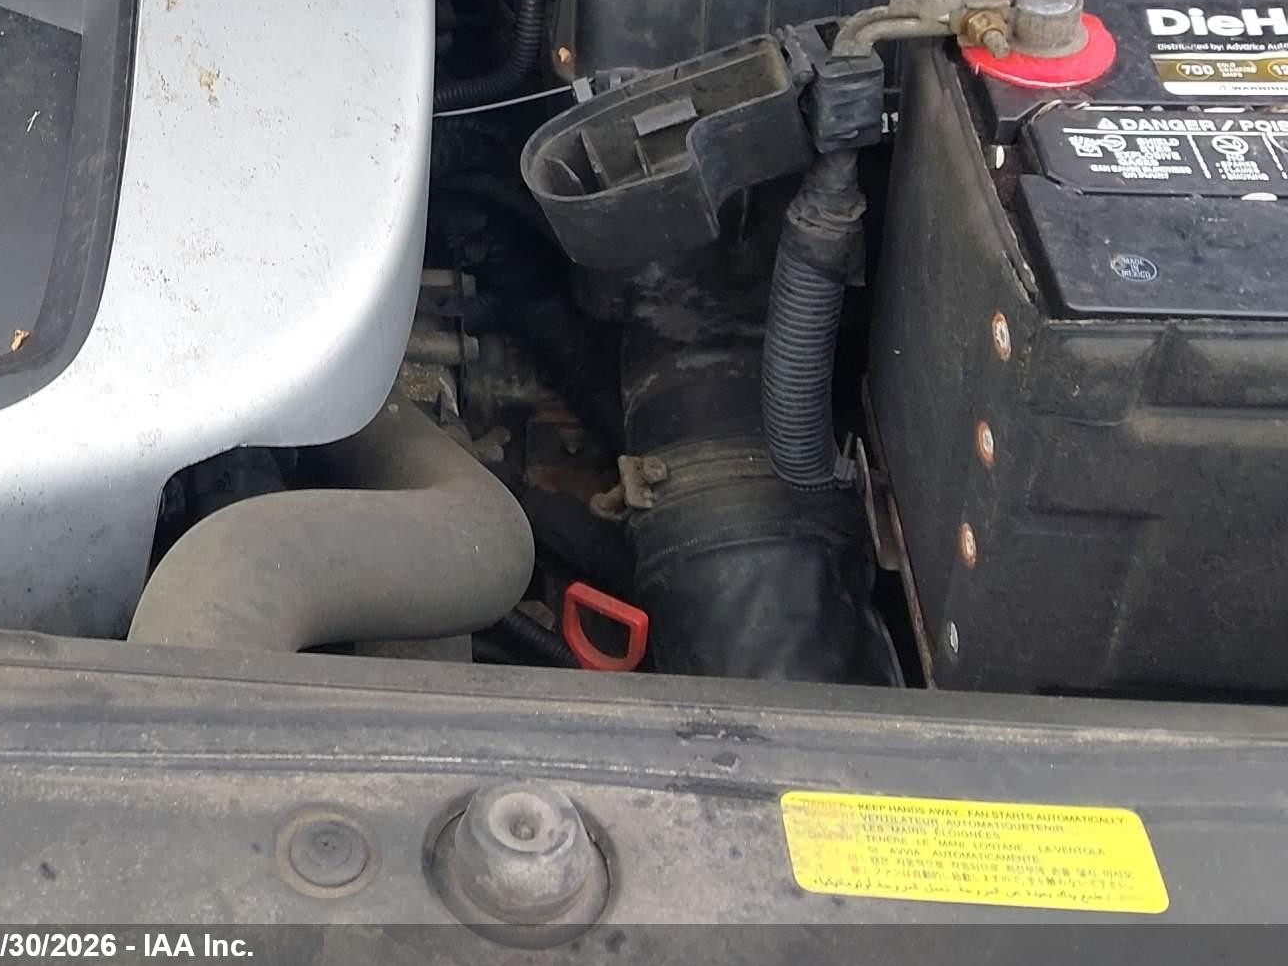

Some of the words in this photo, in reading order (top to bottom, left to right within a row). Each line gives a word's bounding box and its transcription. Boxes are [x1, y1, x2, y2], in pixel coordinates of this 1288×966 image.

[1226, 43, 1265, 52] Advance
[1180, 64, 1215, 76] 700
[1119, 118, 1216, 132] DANGER
[1136, 137, 1180, 147] SHIELD
[858, 803, 885, 813] KEEP
[889, 805, 925, 815] HANDS
[968, 809, 989, 819] FAN
[992, 811, 1033, 821] STARTS
[1037, 813, 1124, 825] AUTOMATICALLY
[860, 814, 938, 825] VENTILATEUR
[891, 826, 927, 835] MAINS
